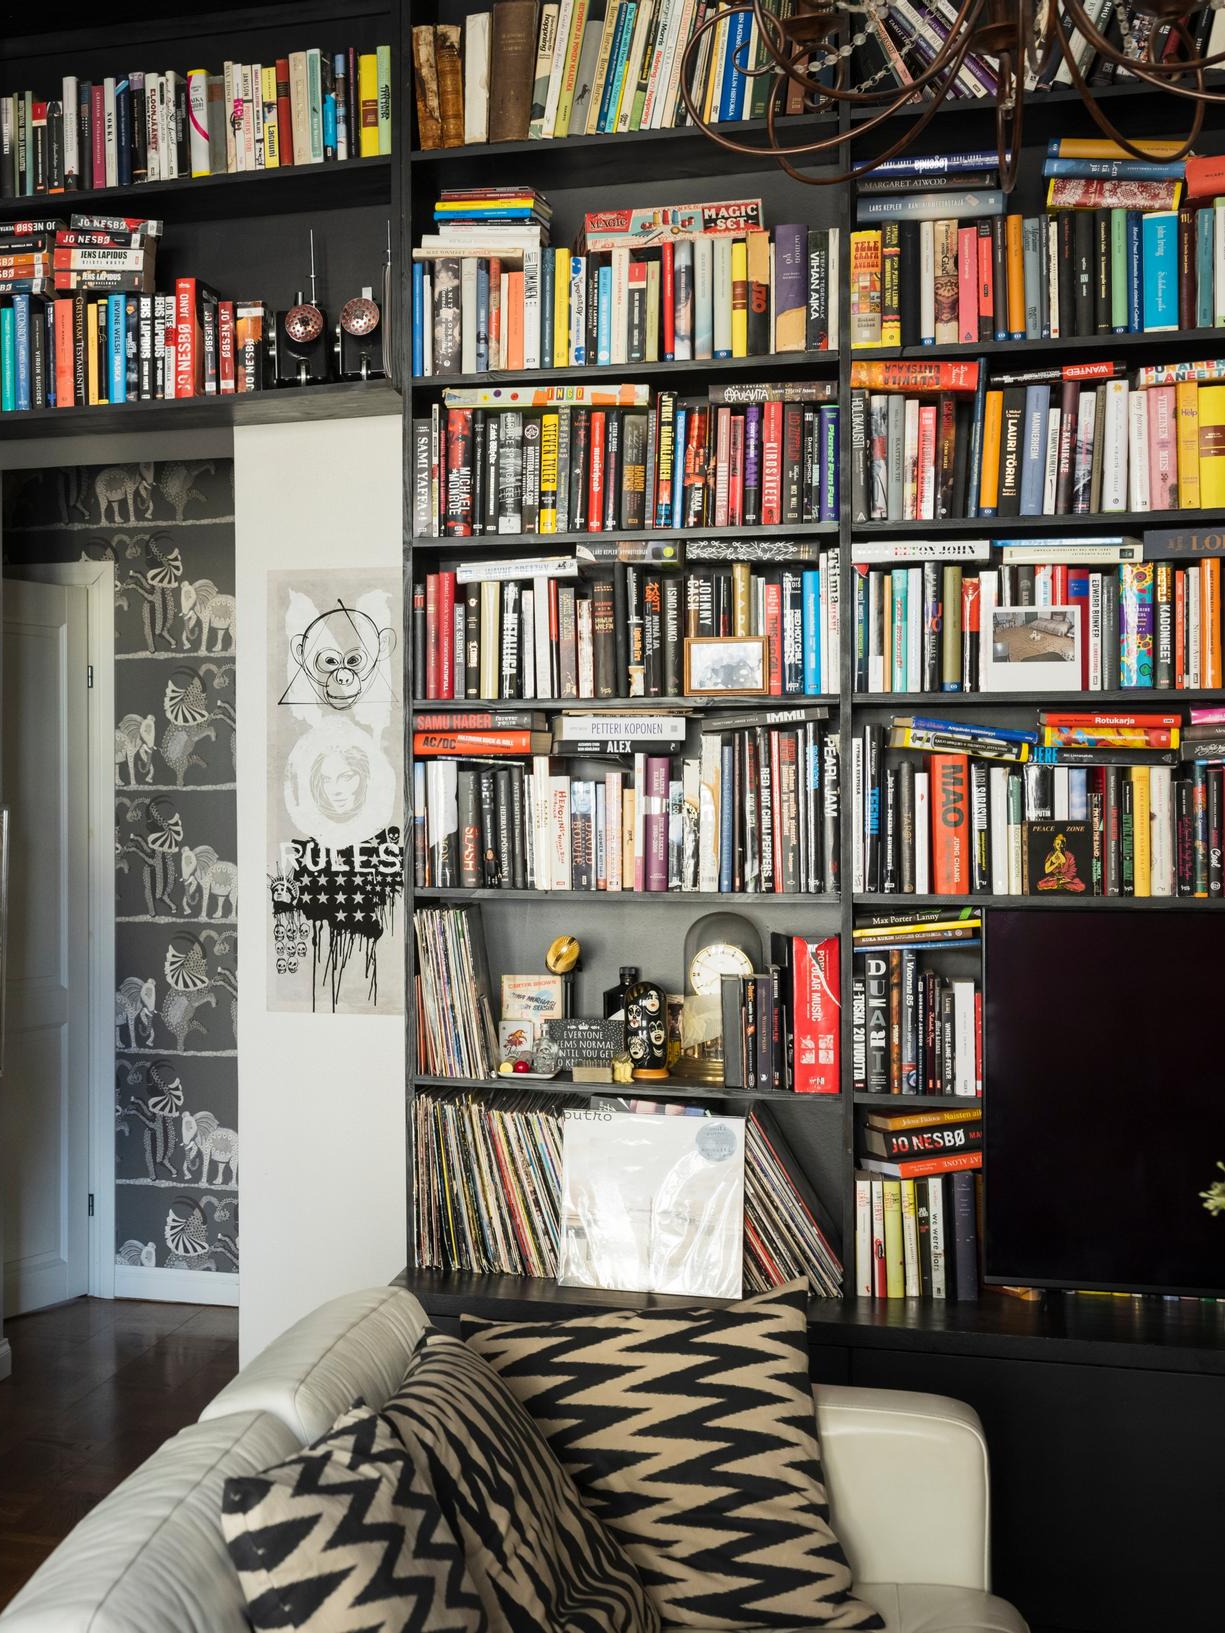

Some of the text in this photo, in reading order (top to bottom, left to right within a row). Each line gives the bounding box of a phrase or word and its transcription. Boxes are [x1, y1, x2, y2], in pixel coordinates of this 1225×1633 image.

[540, 13, 553, 52] hoppning
[575, 2, 586, 32] HEVOSTEN
[570, 41, 579, 63] PONIEN
[242, 73, 250, 97] JANSSON
[566, 64, 576, 92] MAAILMA
[863, 177, 947, 190] MARGARET ATWOOD
[77, 219, 127, 230] JO NESBØ
[704, 204, 758, 230] MAGIC SET
[62, 235, 111, 245] JO NESBØ
[80, 251, 97, 259] JENS
[97, 251, 128, 260] LAPIDUS
[524, 263, 538, 300] TUOMAINEN
[808, 251, 820, 320] VIHAN AIKA
[75, 297, 85, 397] GRISHAM TESTAMENTTI
[177, 293, 192, 397] JO NESBØ JANO
[204, 311, 215, 352] JO NESBØ
[220, 309, 232, 358] JO NESBØ
[244, 338, 256, 390] JO NESBØ
[1066, 365, 1108, 376] WANTED
[545, 387, 585, 401] INGO
[1180, 407, 1198, 418] Help
[659, 395, 674, 480] JYRKI HÄMÄLÄINEN
[851, 397, 864, 449] HOLOKAUSTI
[1030, 412, 1041, 460] MANNERHEIM
[1157, 394, 1169, 471] VIIMEINEN MIES
[504, 416, 516, 504] BRUCE SPRINGSTEEN
[542, 423, 557, 484] STEVEN TYLER
[827, 423, 835, 509] Planet Fun Fun
[1004, 419, 1018, 487] LAURI TÖRNI
[1060, 431, 1071, 473] KAMIKAZE
[417, 436, 429, 511] SAMI YAFFA
[458, 466, 471, 513] MICHAEL
[523, 446, 535, 505] KOTITEOLLISUUS.COM
[623, 465, 645, 491] HANOI ROCKS
[764, 443, 779, 509] KIROSÄKEET
[448, 474, 461, 516] MONROE
[667, 587, 677, 642] ISMO ALANKO
[687, 579, 712, 625] JOHNNY CASH
[1092, 579, 1100, 638] EDWARD BUNKER
[455, 607, 464, 663] BLACK SABBATH
[502, 613, 518, 675] METALLICA
[644, 615, 661, 656] MINÄ JA ANTHRAX
[1159, 604, 1170, 664] KADONNEET
[417, 714, 491, 730] SAMU HABER
[591, 723, 663, 735] PETTERI KOPONEN
[766, 708, 806, 724] IMMU
[1094, 716, 1136, 726] Rotukarja
[422, 736, 456, 750] AC/DC
[607, 741, 631, 753] ALEX
[1033, 746, 1058, 764] JERE
[823, 737, 838, 817] PEARL JAM
[940, 764, 964, 828] MAO
[975, 769, 987, 830] JARI SARASVUO
[499, 806, 509, 876] HERRA YLPÖN SYDÄN
[571, 821, 593, 866] DAVID BOWIE
[760, 768, 773, 877] RED HOT CHILI PEPPERS
[903, 811, 913, 845] TAROT
[279, 841, 402, 874] RULES
[463, 827, 477, 871] SLASH
[1210, 848, 1221, 868] Cool
[872, 912, 939, 925] Max Porter Lanny
[508, 979, 557, 990] CARTER BROWN
[906, 961, 915, 1006] Vuonna 85
[555, 1040, 615, 1049] EEMS NORMAL
[557, 1049, 614, 1058] NTIL YOU GET
[563, 1030, 604, 1040] EVERYONE
[853, 994, 866, 1081] TUSKA 20 VUOTTA
[932, 1213, 942, 1273] we were liars
